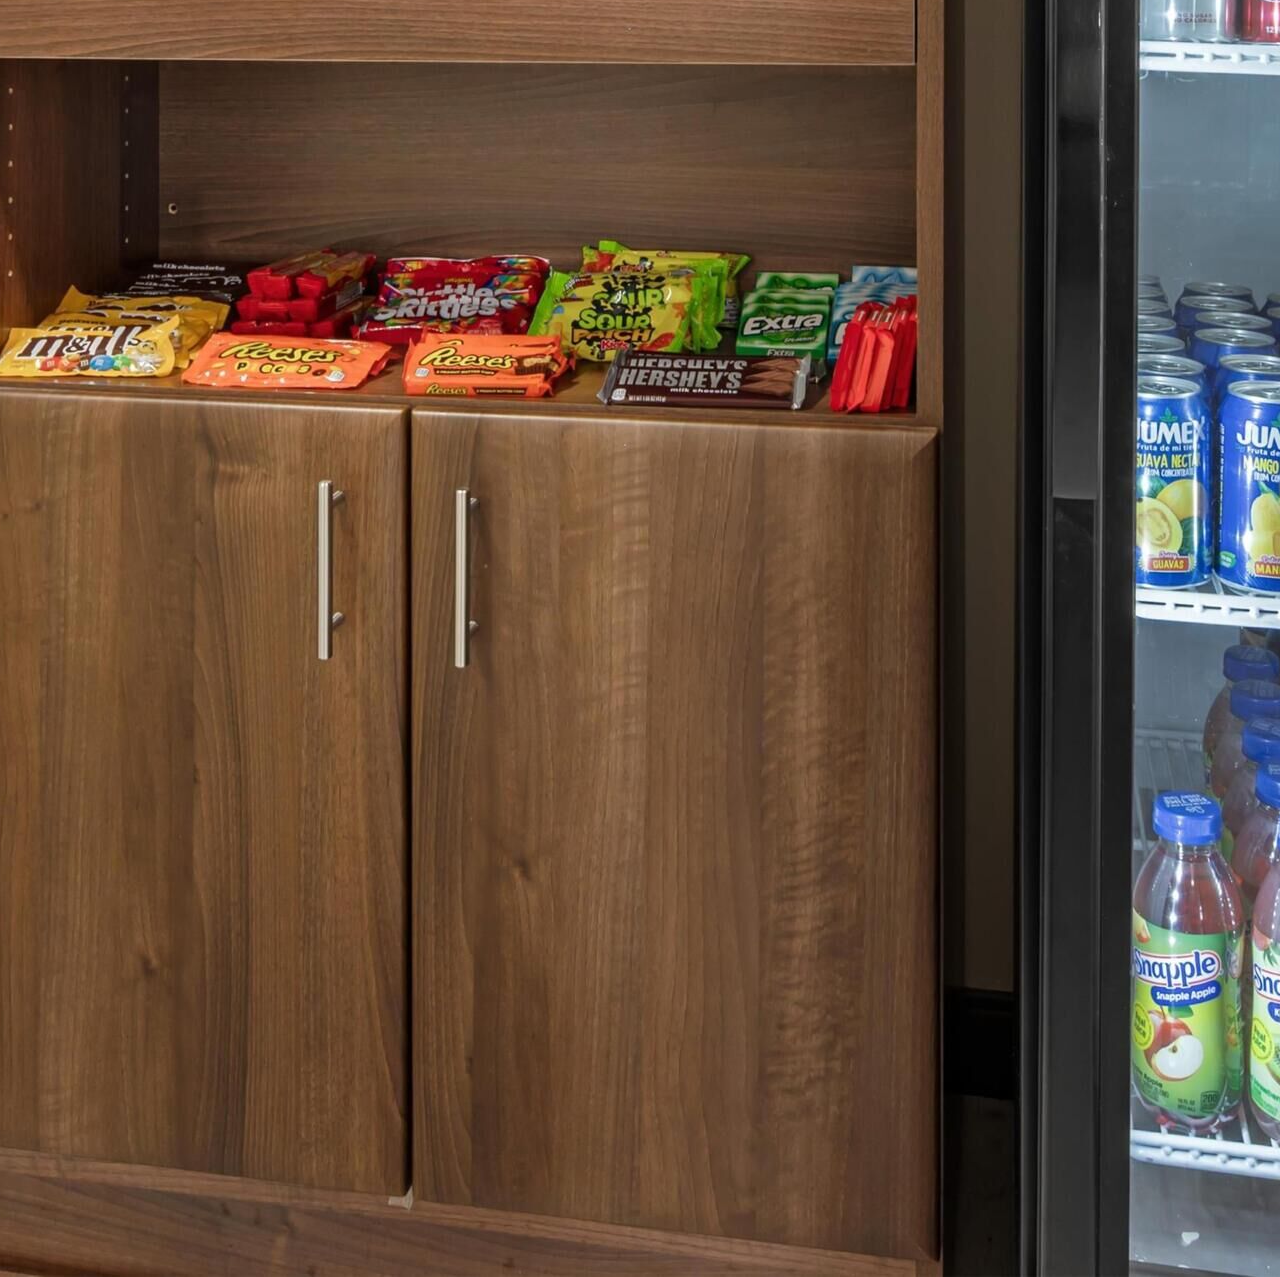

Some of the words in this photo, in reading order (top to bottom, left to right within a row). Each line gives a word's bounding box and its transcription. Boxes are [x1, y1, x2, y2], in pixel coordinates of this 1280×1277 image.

[578, 309, 653, 330] SOUR
[742, 313, 824, 336] Extra
[220, 340, 343, 364] Reese's
[421, 346, 518, 369] Reese's
[426, 383, 468, 395] Reese's
[619, 370, 743, 390] HERSHEY'S
[1246, 446, 1269, 456] Fruta
[1269, 448, 1280, 456] de
[1151, 558, 1186, 570] GUAVAS
[1133, 950, 1218, 988] Snapple
[1156, 988, 1190, 1003] Snapple
[1191, 983, 1217, 999] Apple
